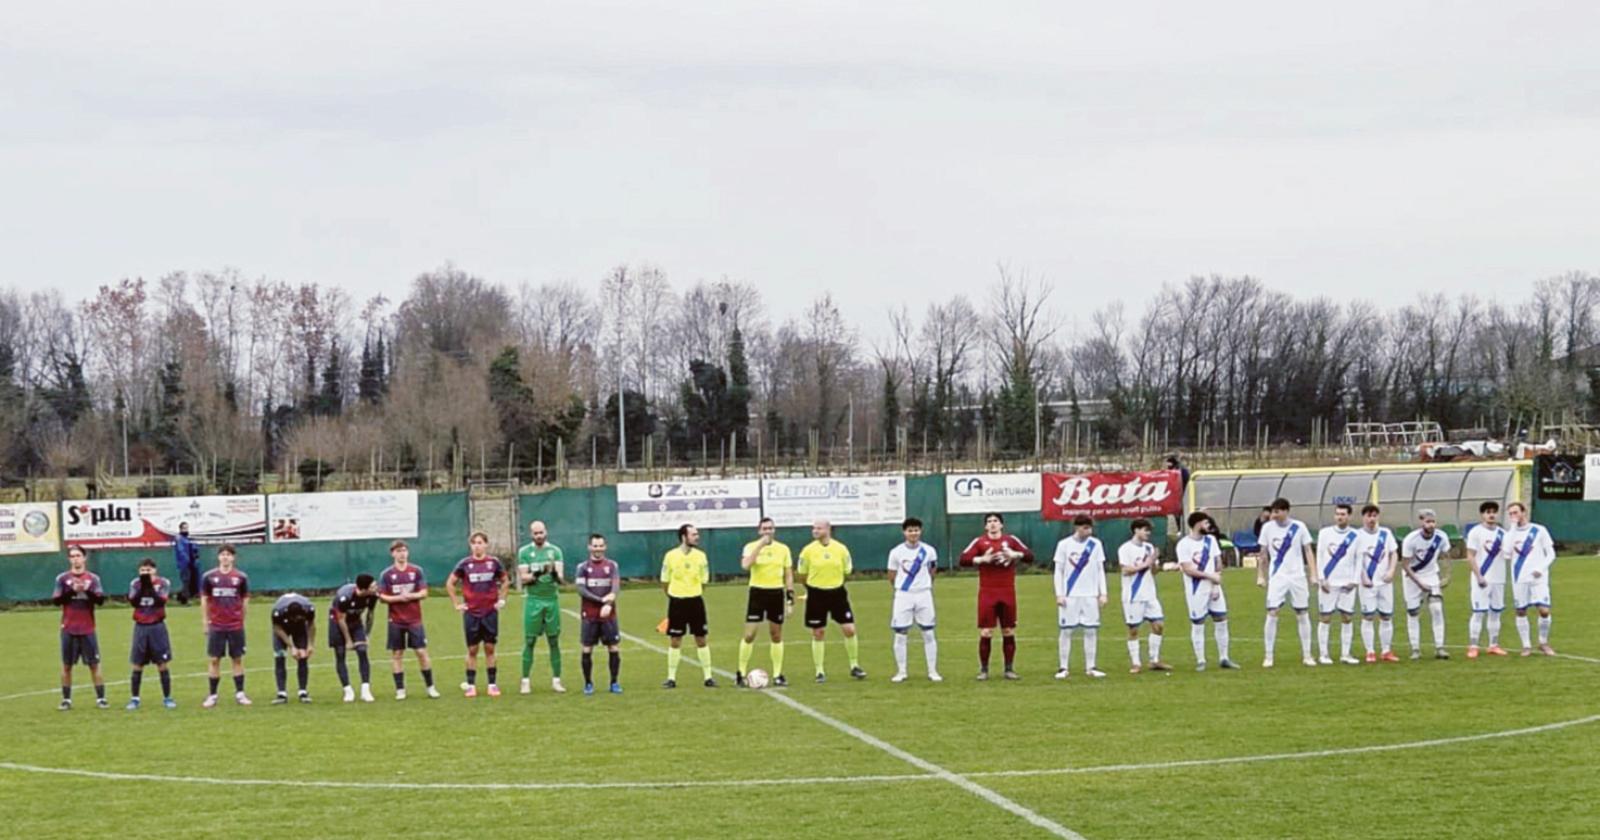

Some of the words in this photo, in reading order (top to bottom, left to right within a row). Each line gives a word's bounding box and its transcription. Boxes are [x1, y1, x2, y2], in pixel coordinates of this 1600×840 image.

[954, 478, 983, 497] CA
[985, 487, 1035, 497] CARTURAN
[1052, 476, 1171, 506] Bata
[1332, 495, 1357, 505] LOCALI
